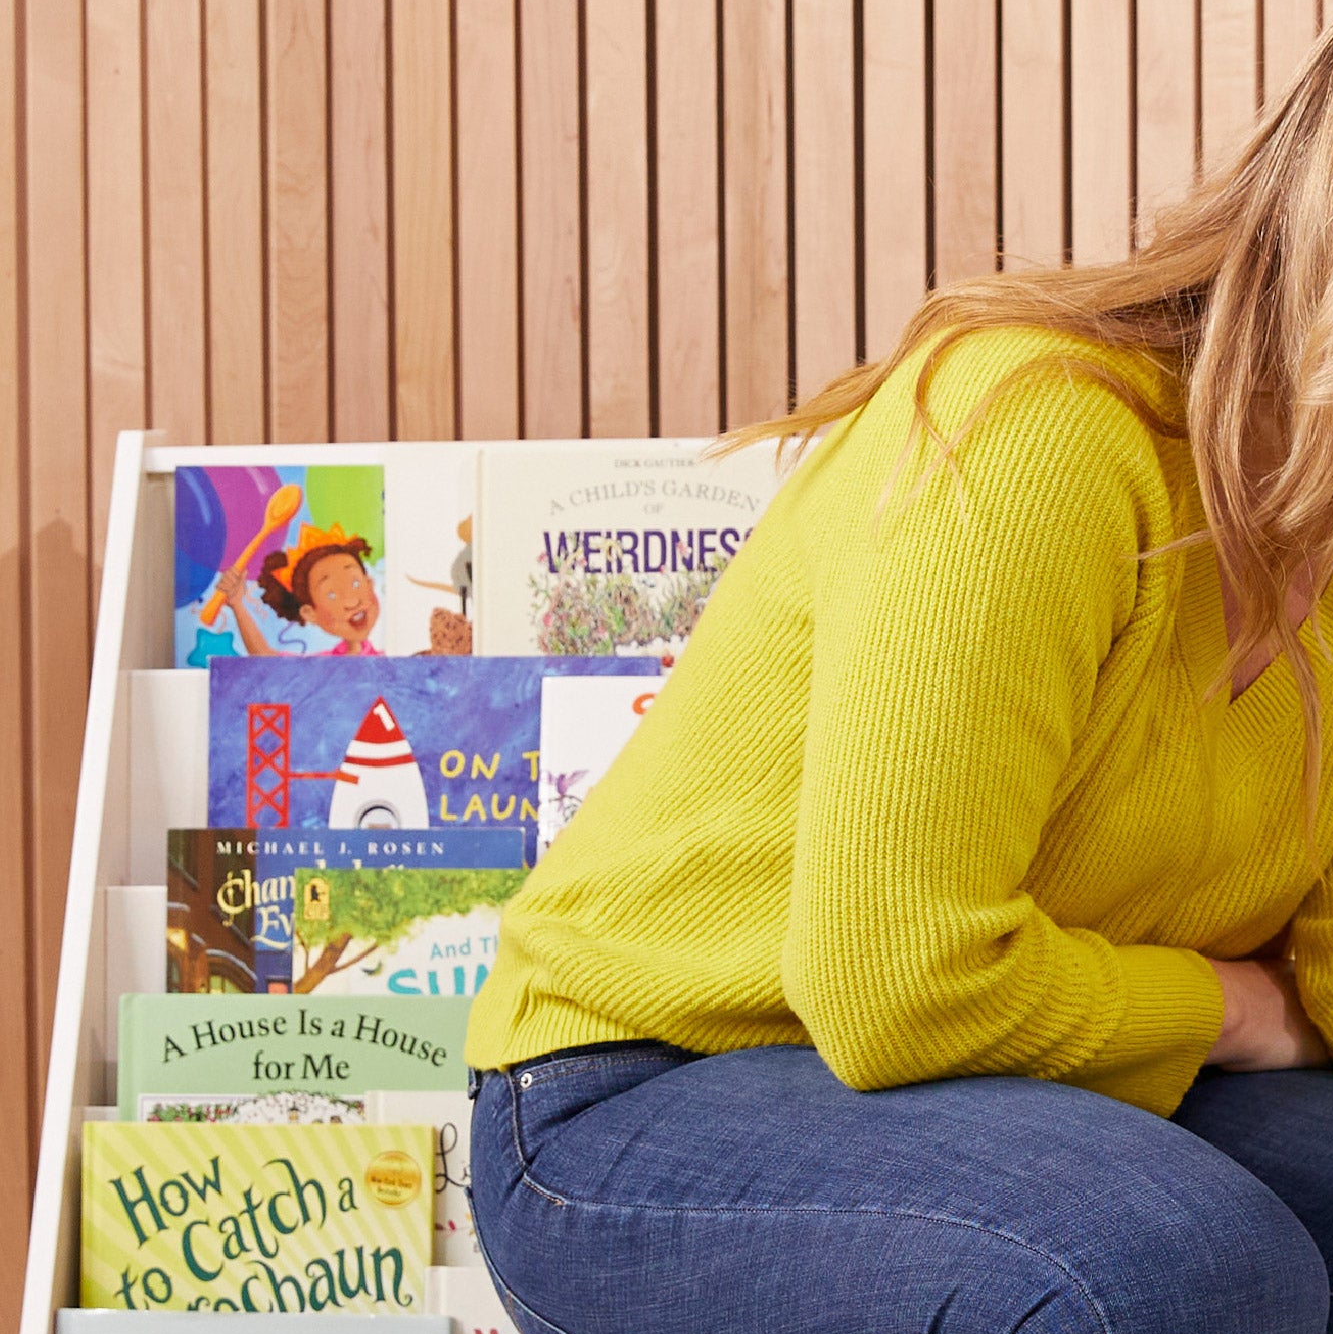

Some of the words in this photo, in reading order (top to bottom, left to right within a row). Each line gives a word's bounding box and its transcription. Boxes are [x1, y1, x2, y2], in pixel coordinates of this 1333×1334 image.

[549, 499, 565, 515] A
[569, 479, 656, 507] CHILD'S
[661, 479, 761, 512] GARDEN
[643, 503, 663, 514] OF
[543, 528, 753, 573] WEIRDNES
[439, 750, 501, 780] ON
[216, 841, 325, 855] MICHAEL
[338, 841, 351, 855] J.
[367, 841, 445, 855] ROSEN
[430, 936, 471, 960] And
[162, 1035, 187, 1063] A
[191, 1015, 287, 1050] House
[298, 1009, 322, 1036] Is
[331, 1019, 346, 1038] a
[353, 1013, 448, 1067] House
[252, 1049, 295, 1081] for
[301, 1053, 351, 1080] Me
[109, 1155, 222, 1249] How
[182, 1158, 326, 1282] Catch
[337, 1176, 359, 1213] a
[114, 1265, 172, 1310] to
